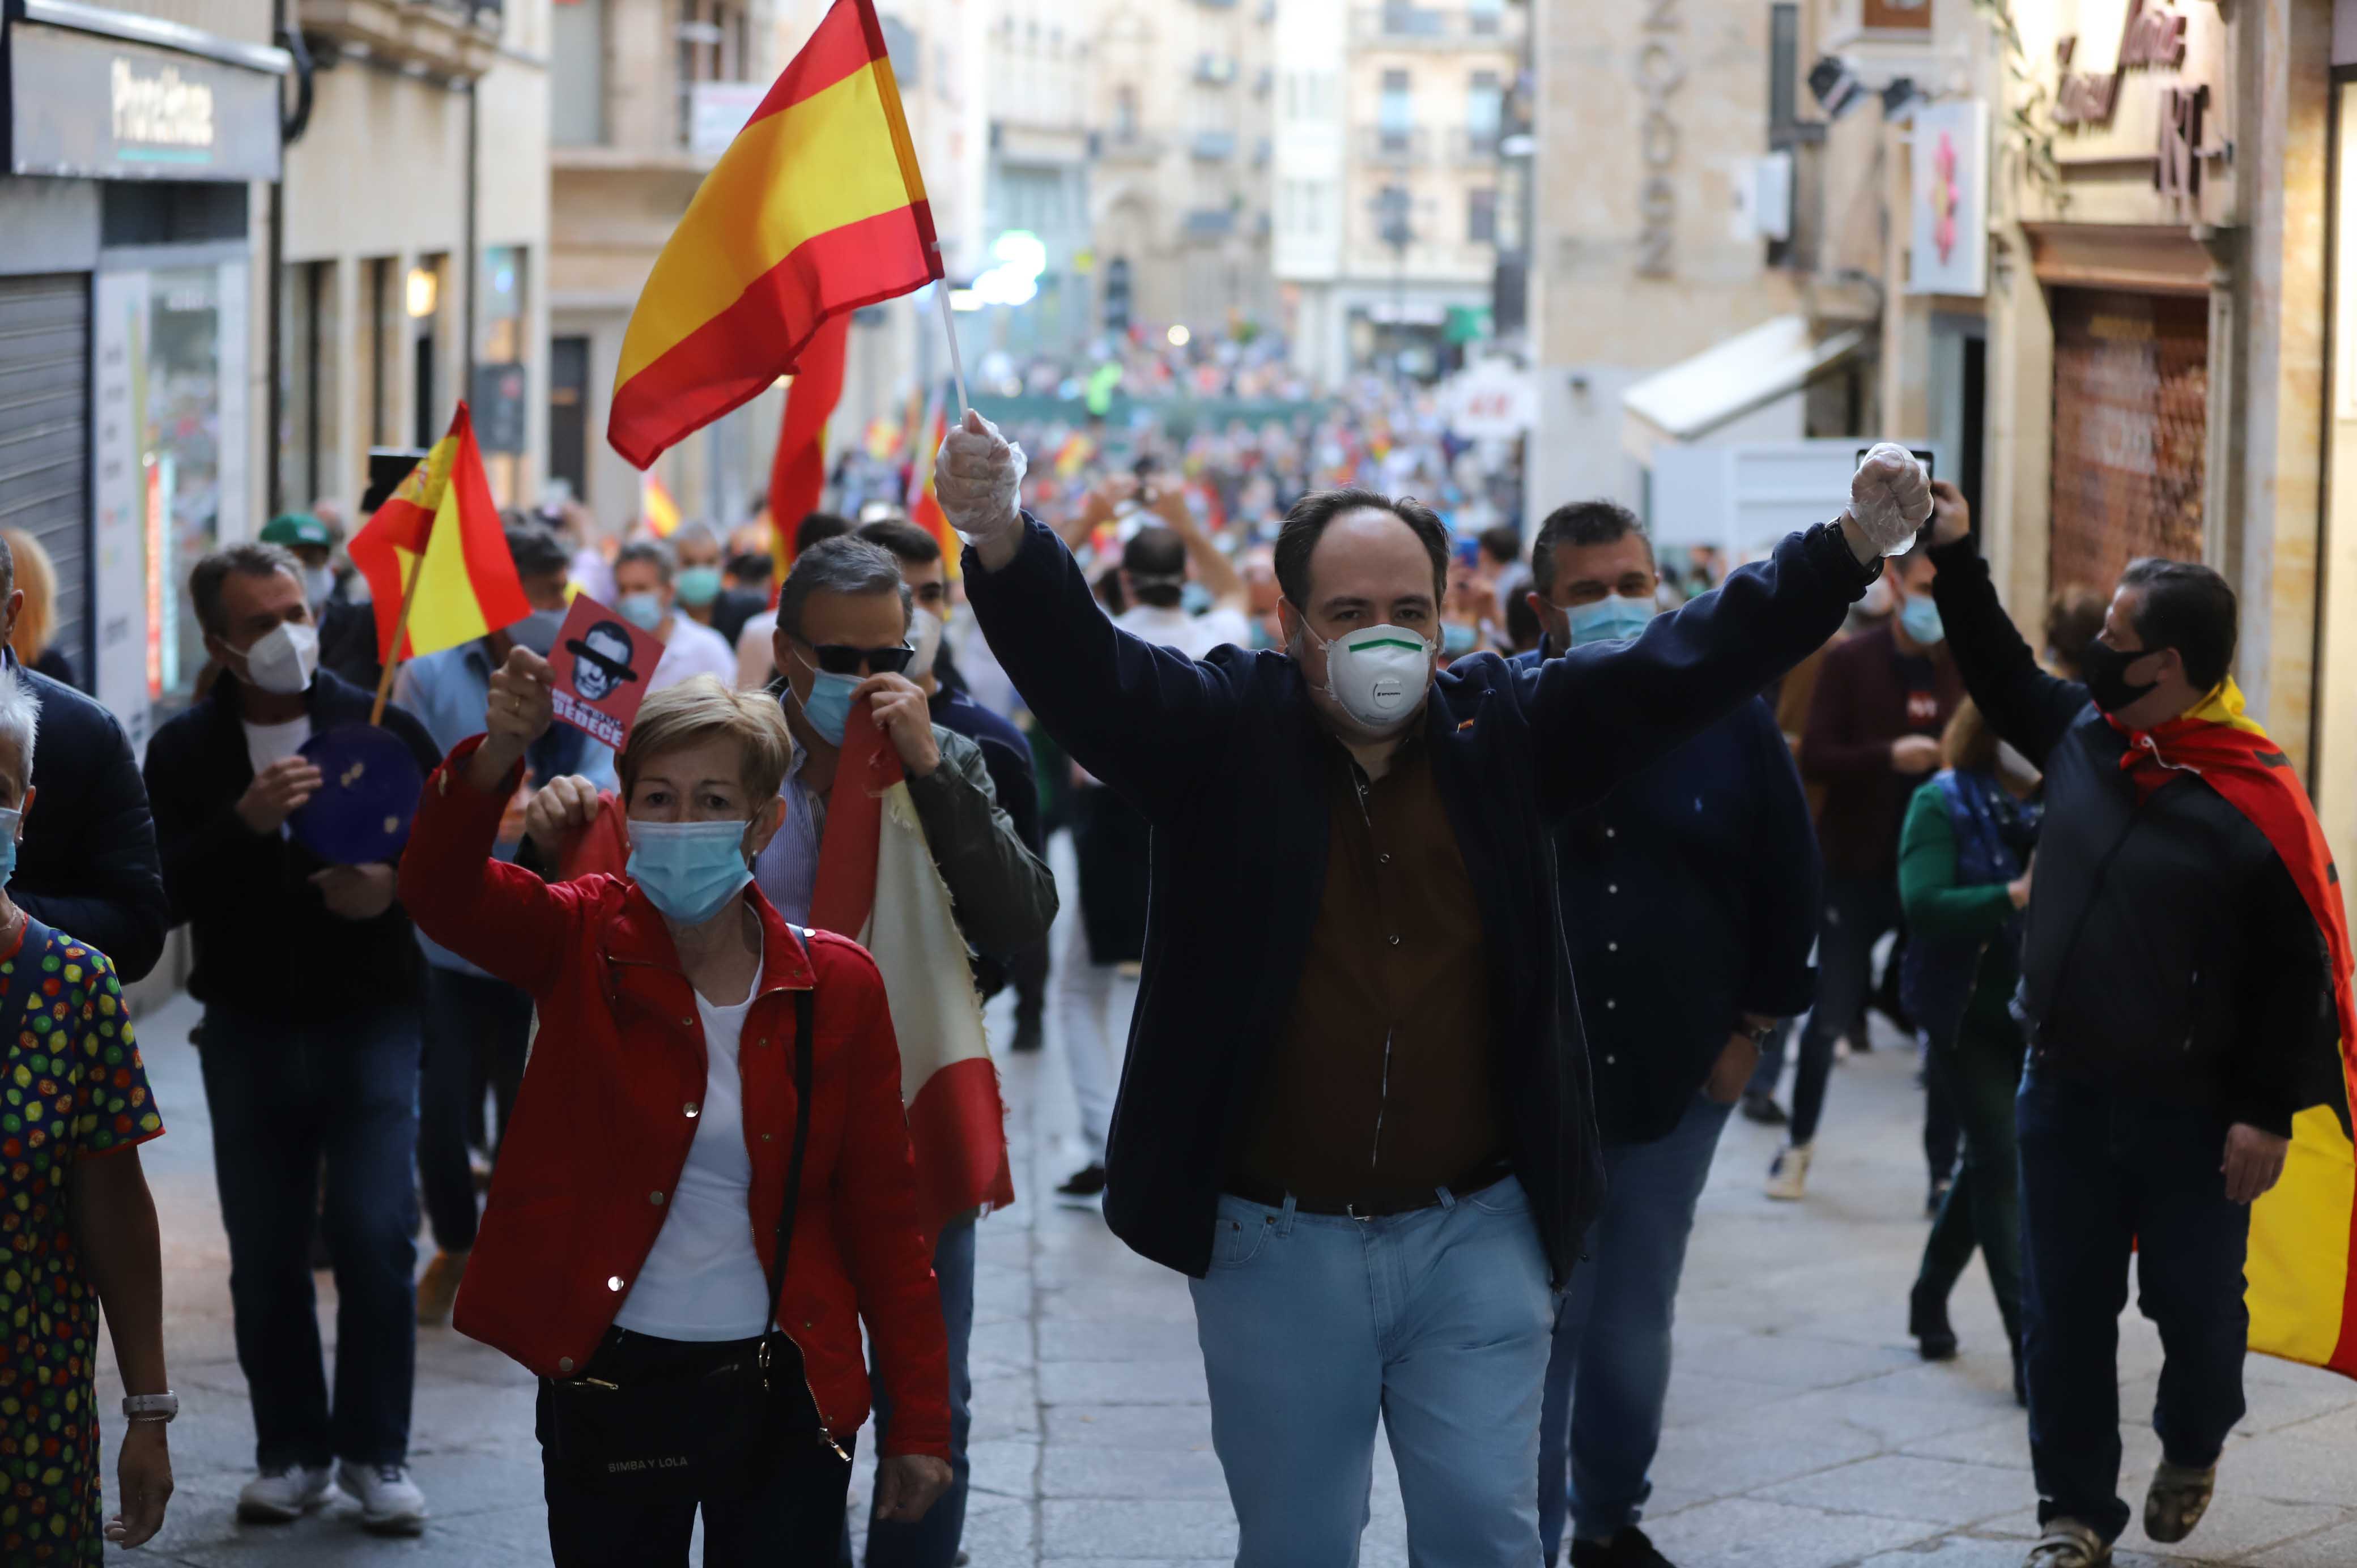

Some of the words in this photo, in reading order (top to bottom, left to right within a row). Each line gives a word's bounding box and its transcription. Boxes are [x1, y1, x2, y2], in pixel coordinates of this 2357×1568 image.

[552, 696, 623, 748] BEDECE
[607, 1460, 646, 1473] BIMBA
[648, 1459, 655, 1468] Y
[658, 1456, 688, 1468] LOLA
